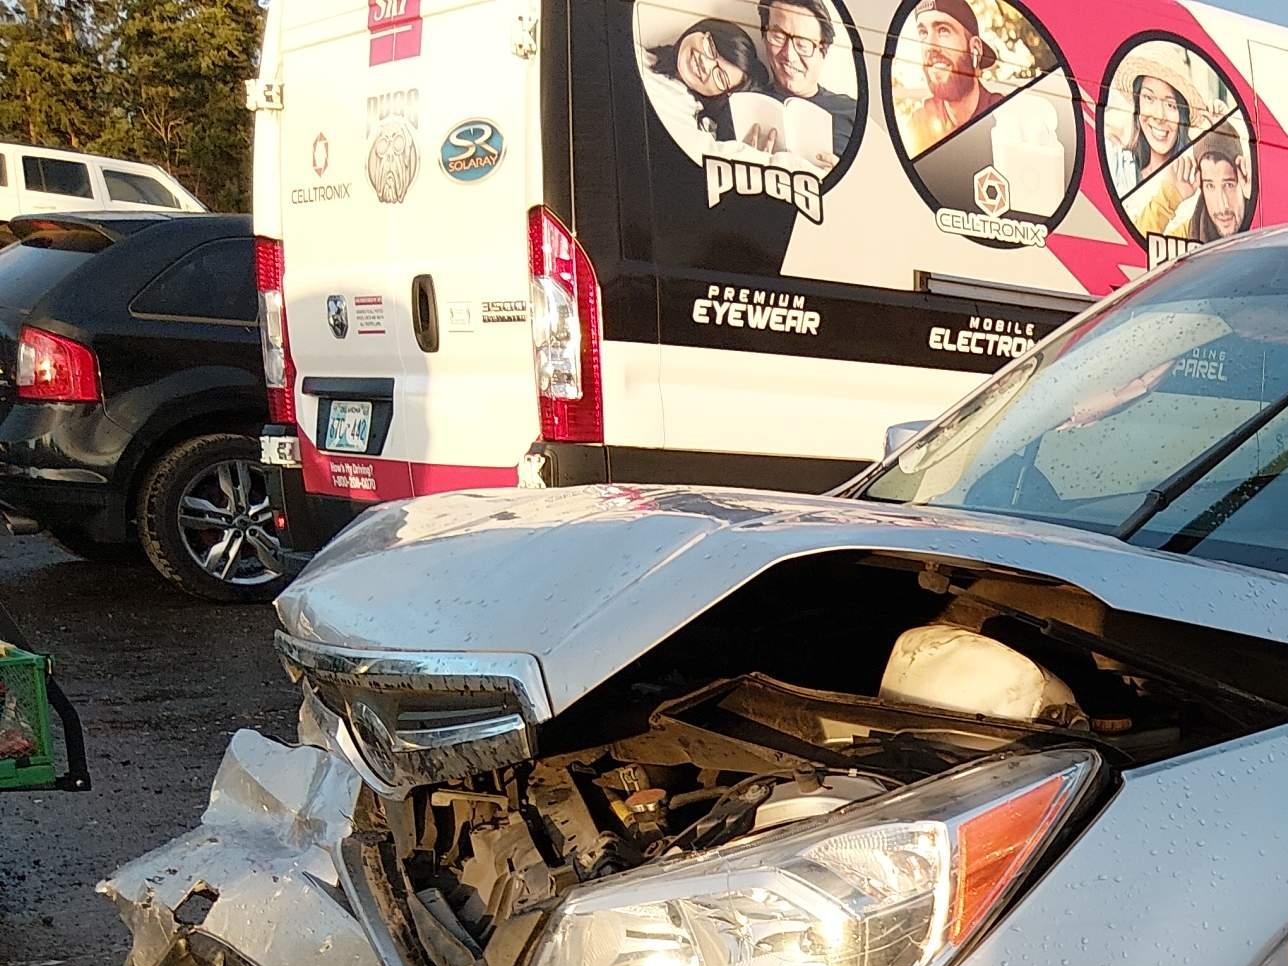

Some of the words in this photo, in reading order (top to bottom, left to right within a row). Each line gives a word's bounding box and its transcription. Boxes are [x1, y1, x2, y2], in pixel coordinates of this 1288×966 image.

[448, 156, 497, 172] SOLARAY
[291, 184, 351, 204] CELLTRONIX
[704, 156, 823, 224] PUGS
[939, 212, 1043, 243] CELLTRONIX
[481, 300, 526, 312] 3500
[708, 285, 805, 309] PREMIUM
[692, 299, 821, 335] EYEWEAR
[969, 316, 1035, 336] MOBILE
